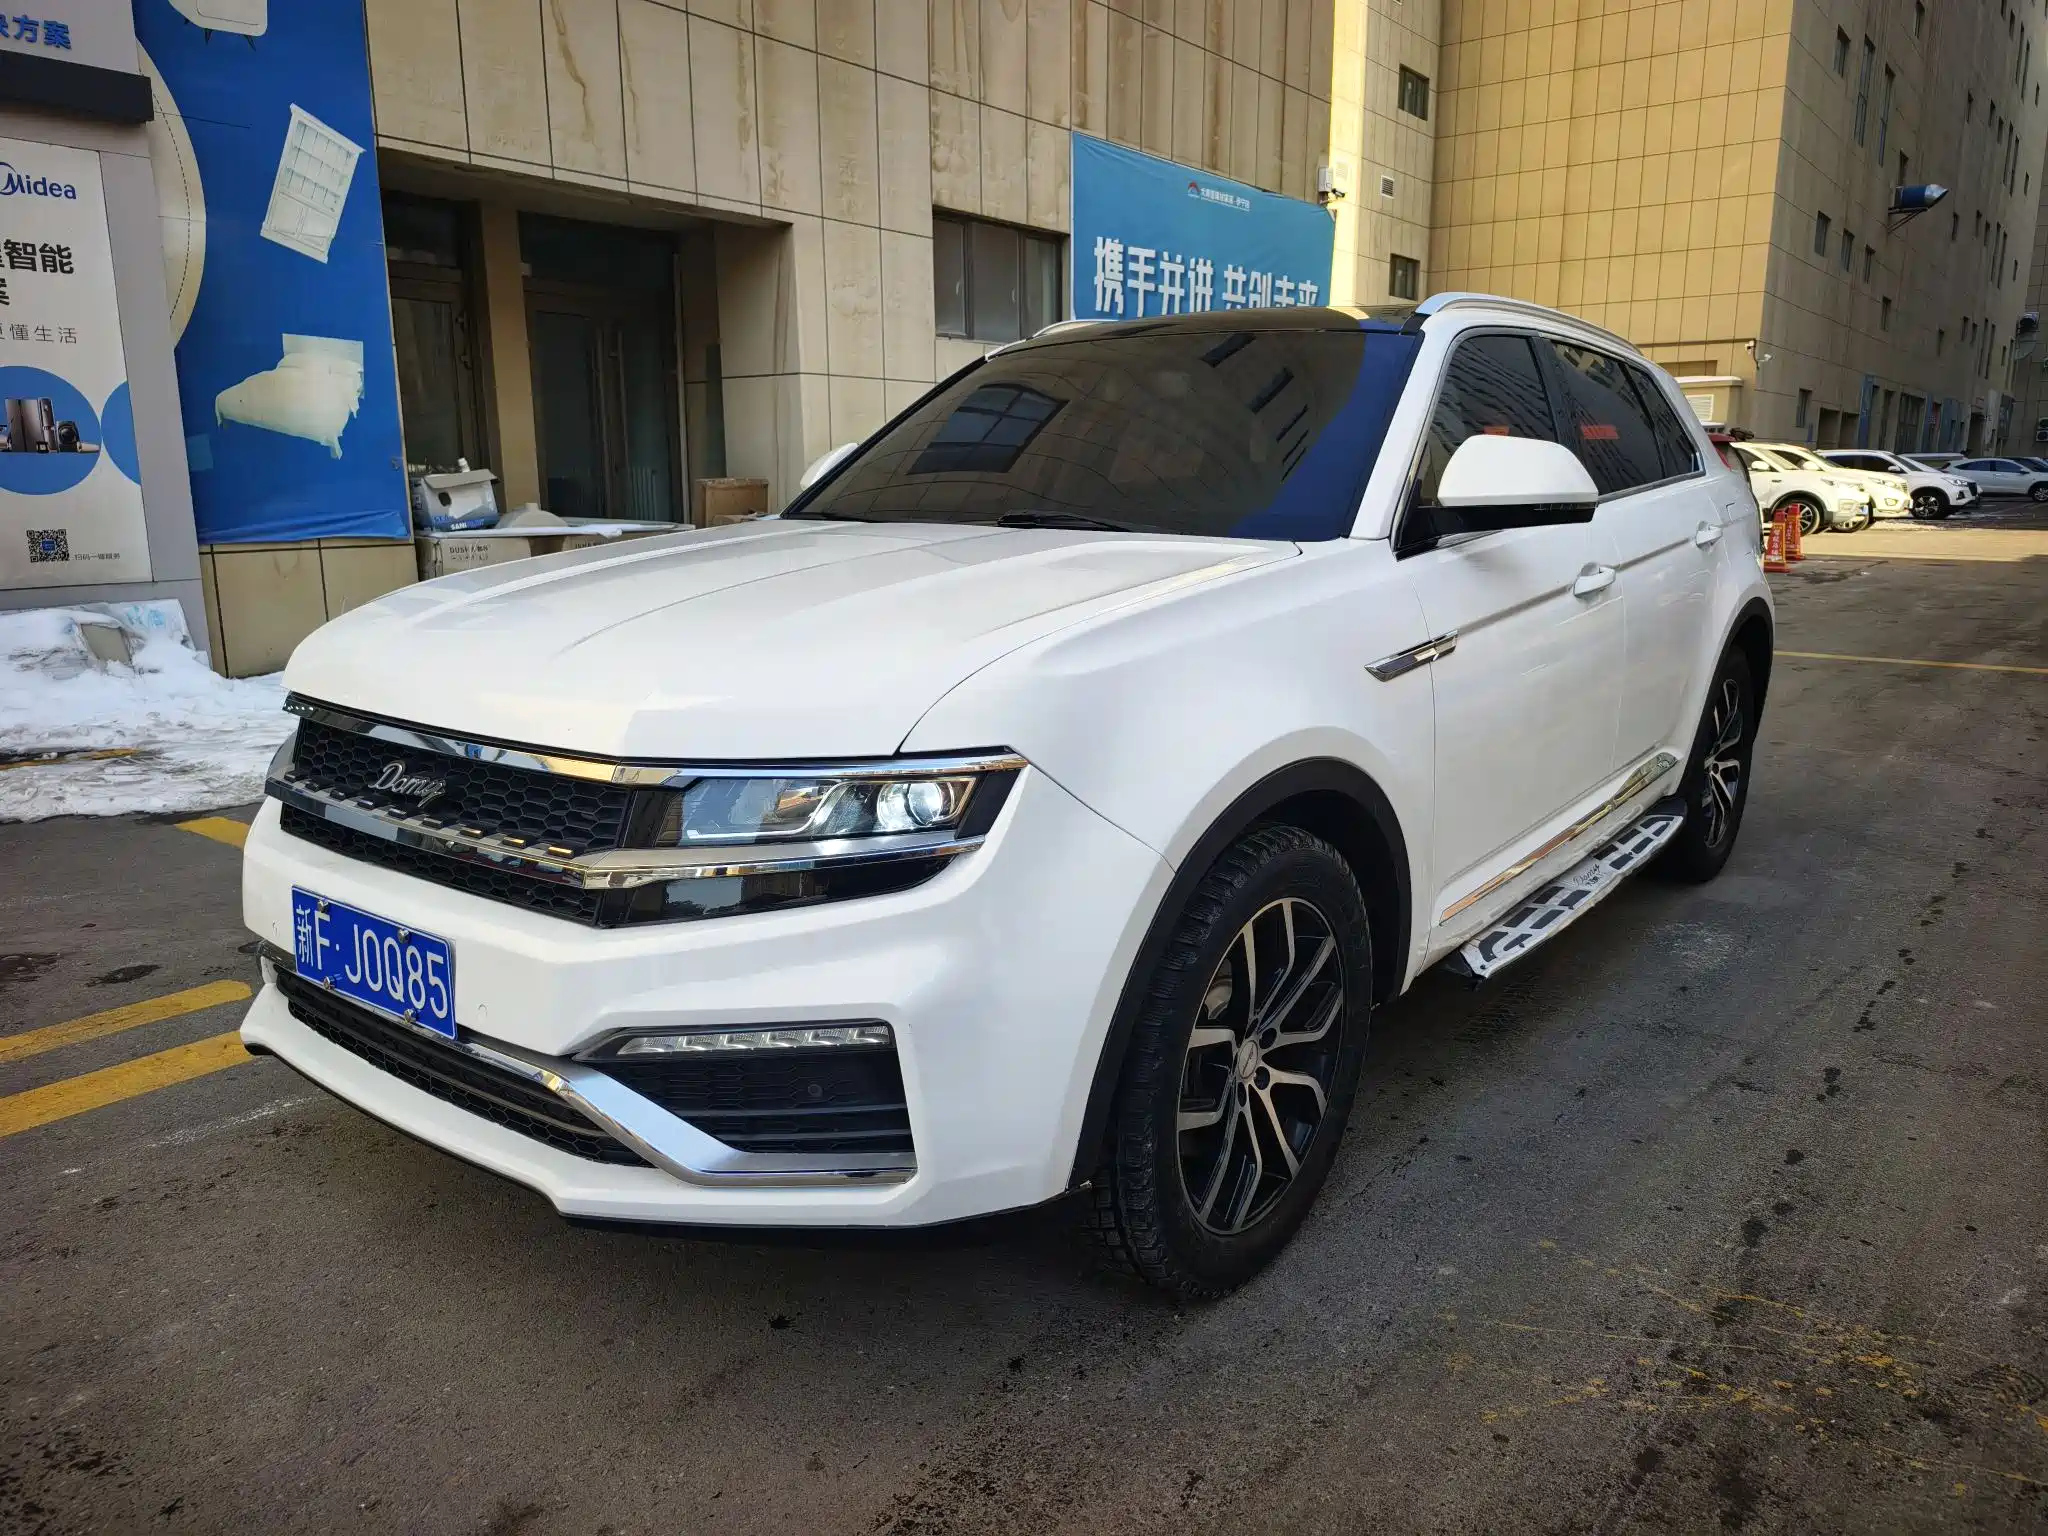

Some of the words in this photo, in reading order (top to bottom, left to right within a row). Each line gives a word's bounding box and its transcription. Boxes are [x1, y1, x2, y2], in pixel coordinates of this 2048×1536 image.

[0, 166, 77, 200] Midea
[0, 238, 75, 275] 智能
[0, 322, 78, 344] 懂生活
